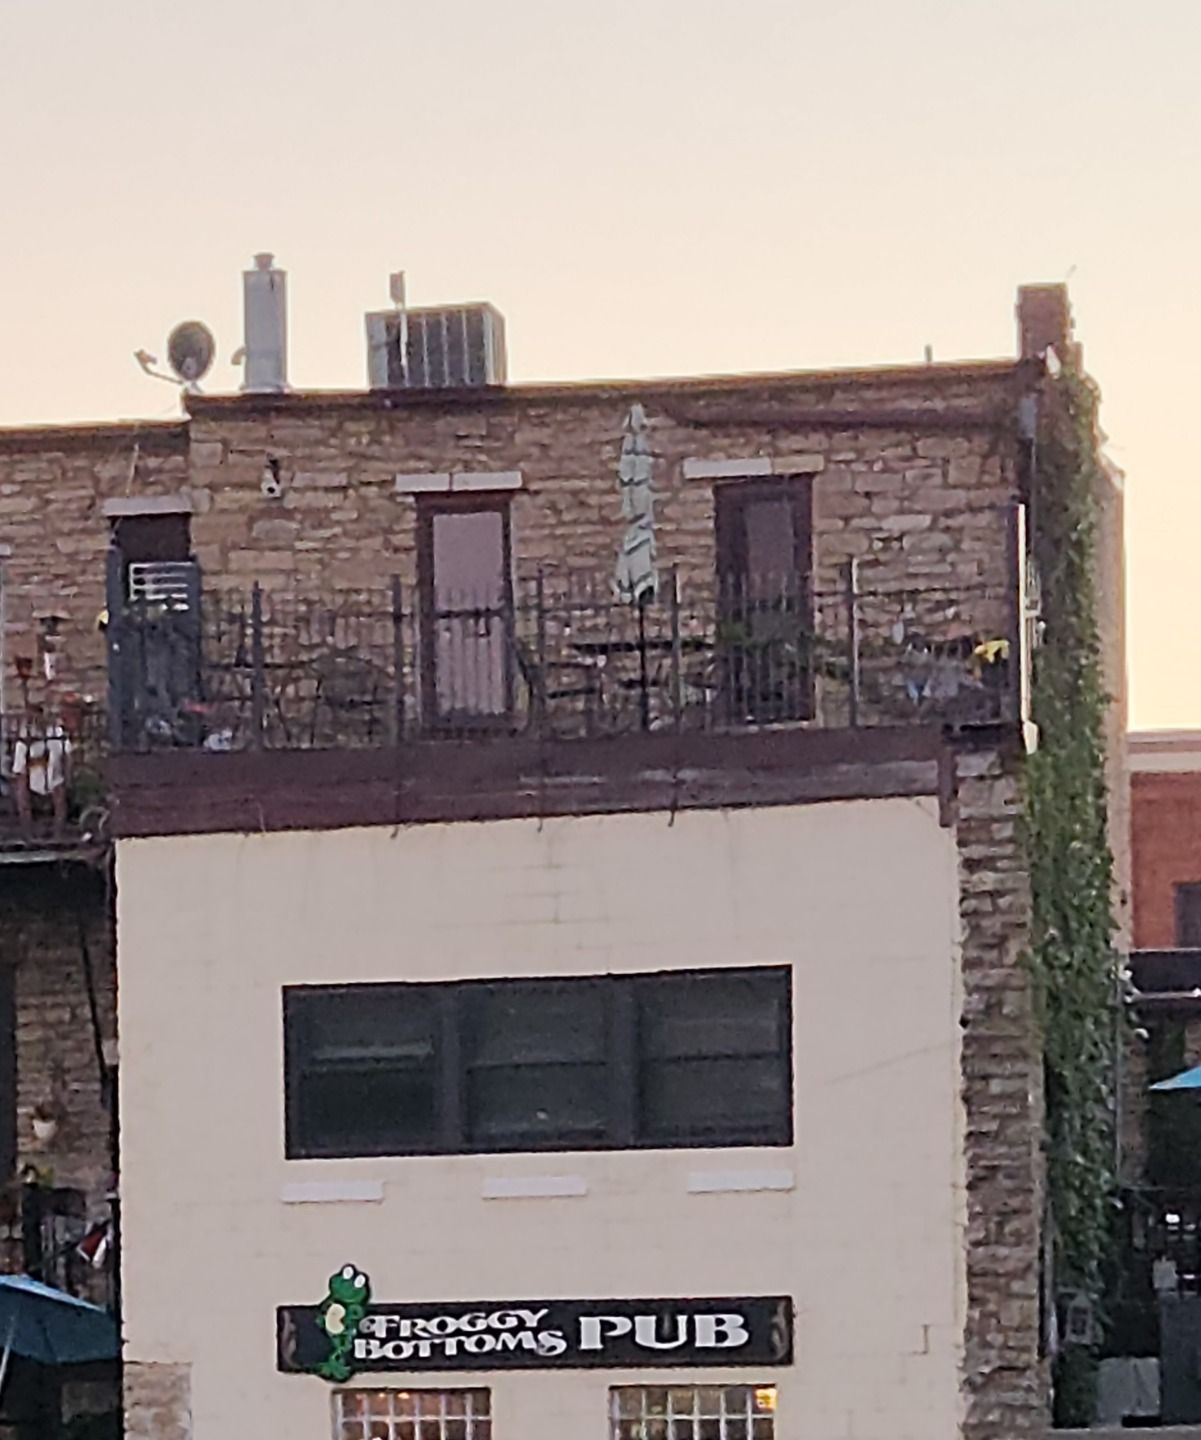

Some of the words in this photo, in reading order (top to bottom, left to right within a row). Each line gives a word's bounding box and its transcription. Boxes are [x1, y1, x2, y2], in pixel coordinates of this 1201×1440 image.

[359, 1309, 549, 1338] FROGGY
[578, 1314, 749, 1350] PUB
[354, 1330, 567, 1359] BOTTOMS
